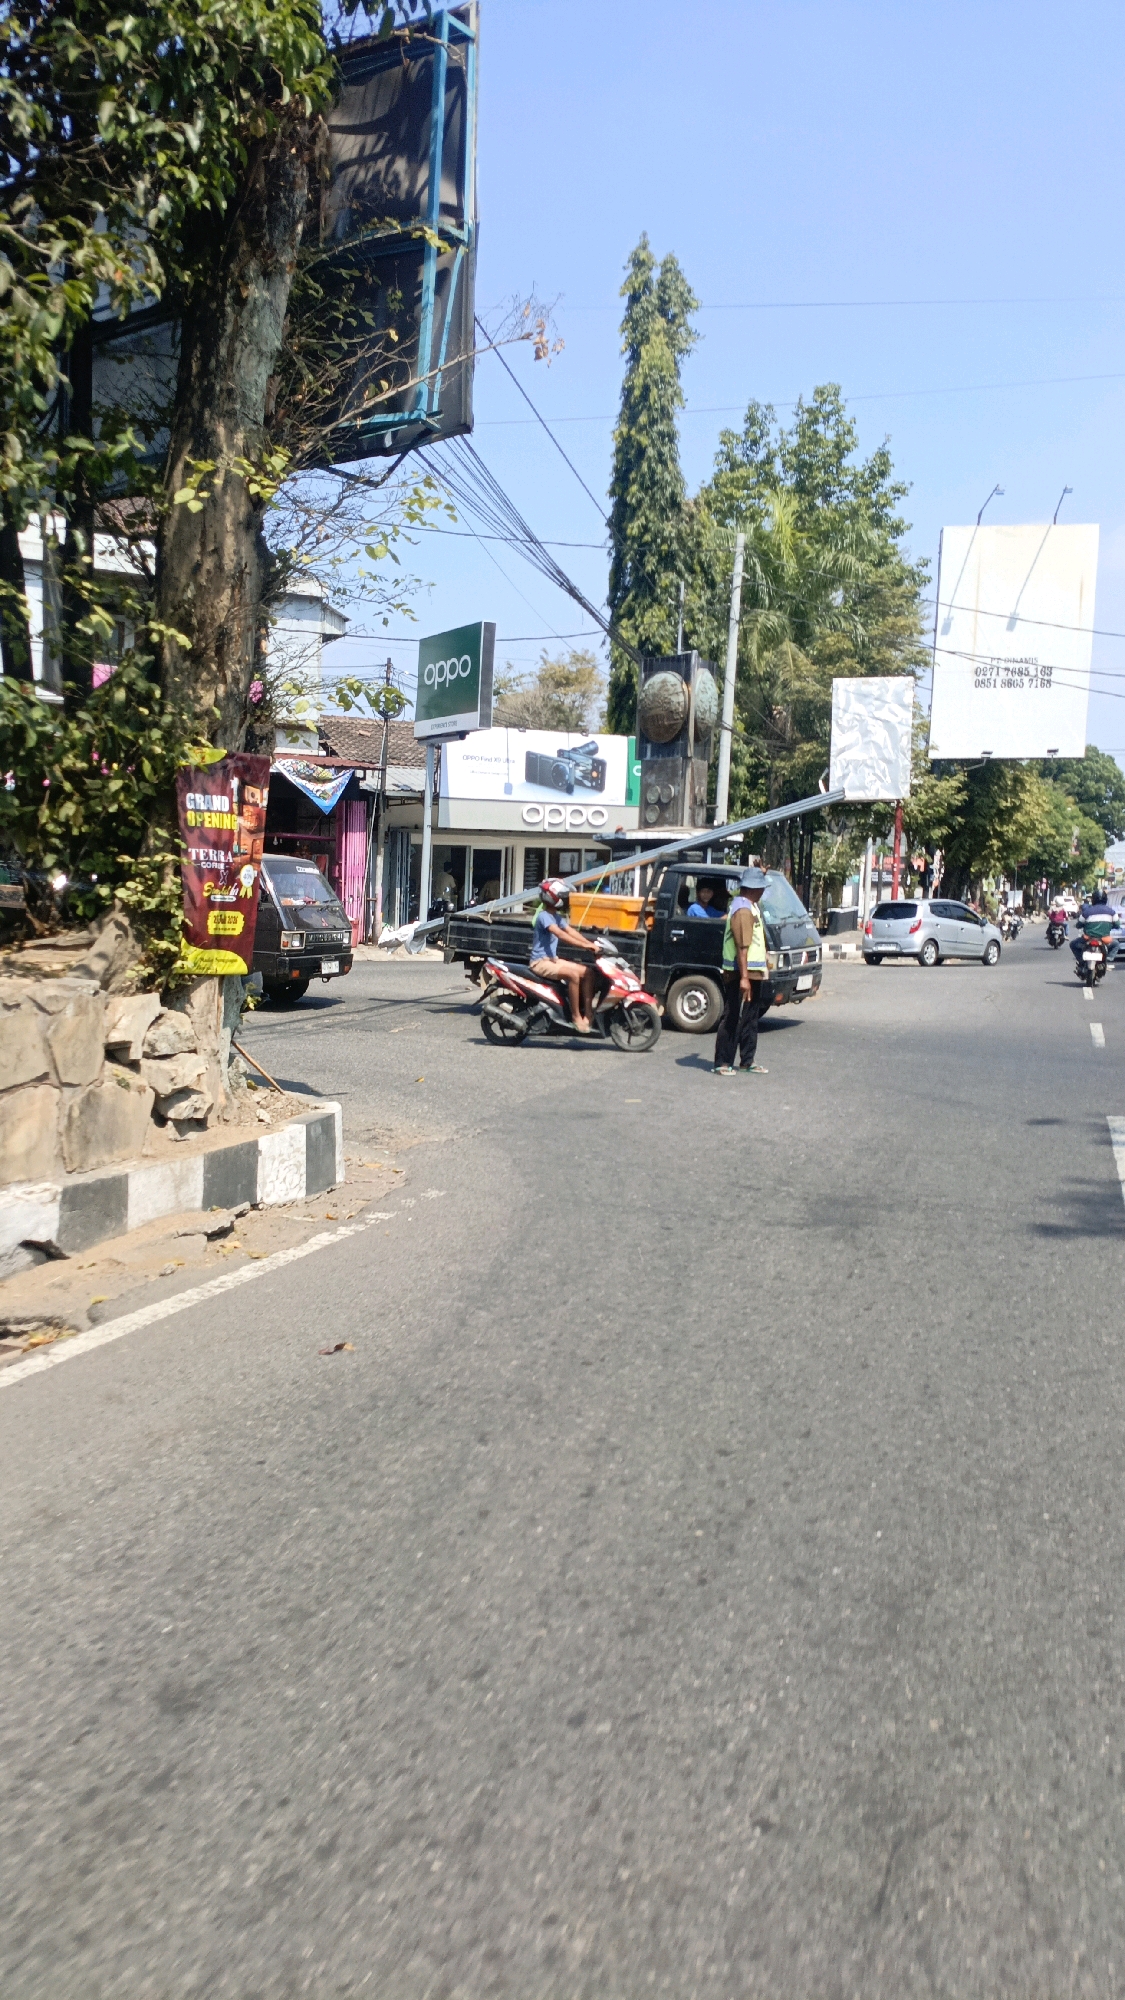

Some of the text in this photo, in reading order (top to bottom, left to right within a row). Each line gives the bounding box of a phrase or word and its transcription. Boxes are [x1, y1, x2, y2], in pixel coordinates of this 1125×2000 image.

[424, 655, 471, 690] oppo
[975, 666, 1000, 677] 0271
[974, 678, 997, 689] 0851
[186, 792, 230, 812] GRAND
[187, 810, 238, 830] OPENING
[522, 803, 609, 830] oppo
[188, 848, 233, 862] TERRA
